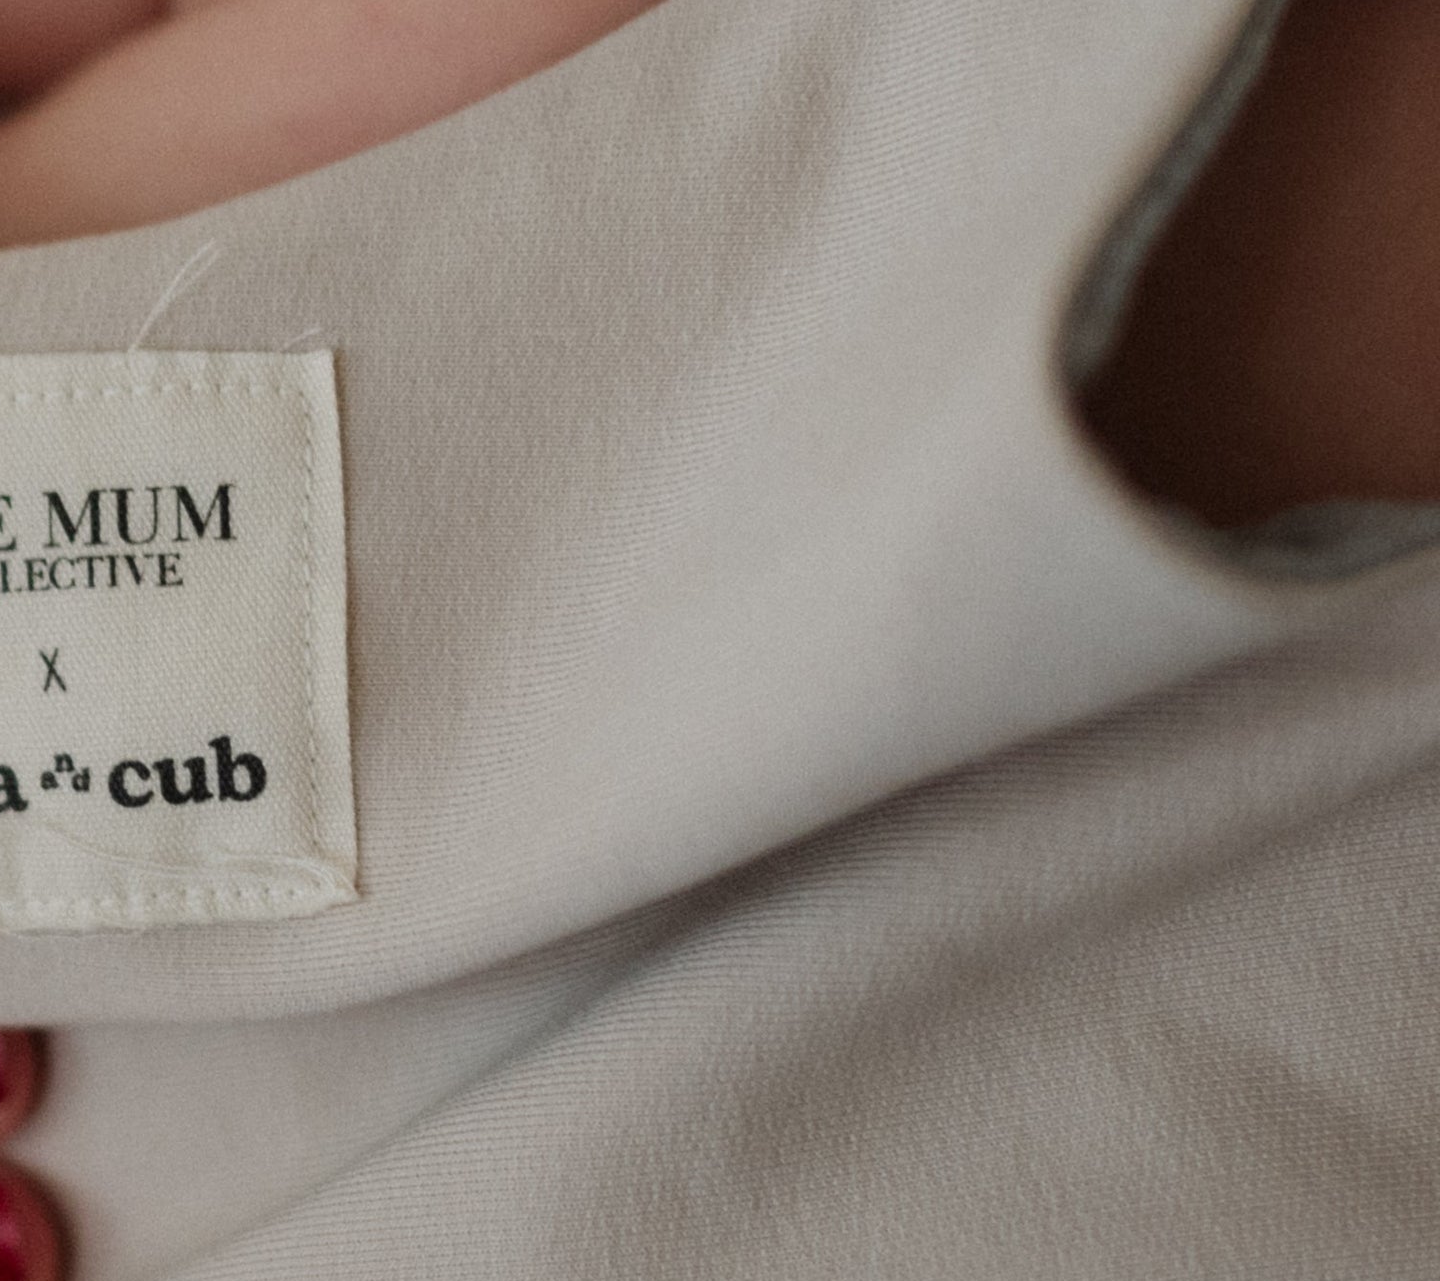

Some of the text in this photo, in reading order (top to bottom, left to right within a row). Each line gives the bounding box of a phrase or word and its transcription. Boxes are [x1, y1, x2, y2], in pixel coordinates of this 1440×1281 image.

[42, 482, 238, 549] MUM
[40, 752, 91, 793] and
[107, 734, 268, 809] cub
